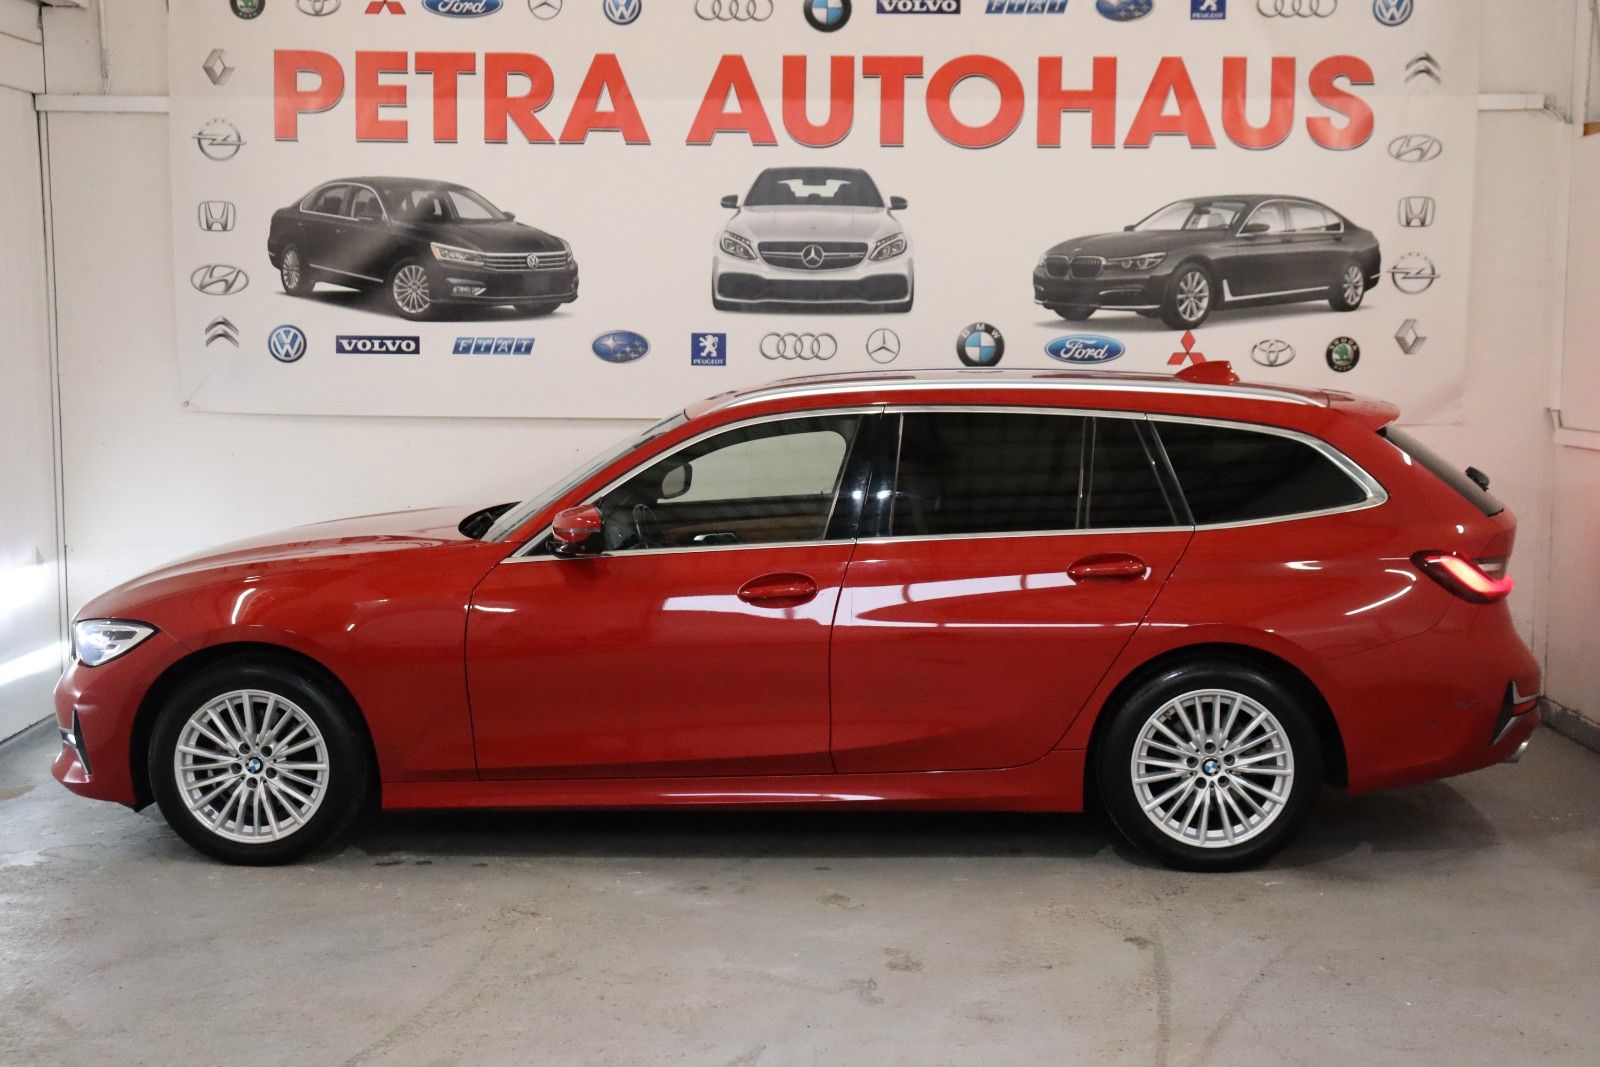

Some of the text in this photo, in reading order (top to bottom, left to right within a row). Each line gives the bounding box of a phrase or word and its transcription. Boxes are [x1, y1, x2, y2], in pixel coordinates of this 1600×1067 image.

[881, 0, 957, 12] VOLVO
[273, 49, 1375, 150] PETRA AUTOHAUS
[961, 323, 1000, 339] BMW
[339, 339, 416, 352] VOLVO
[458, 340, 530, 352] FIAT
[1060, 338, 1110, 359] Ford
